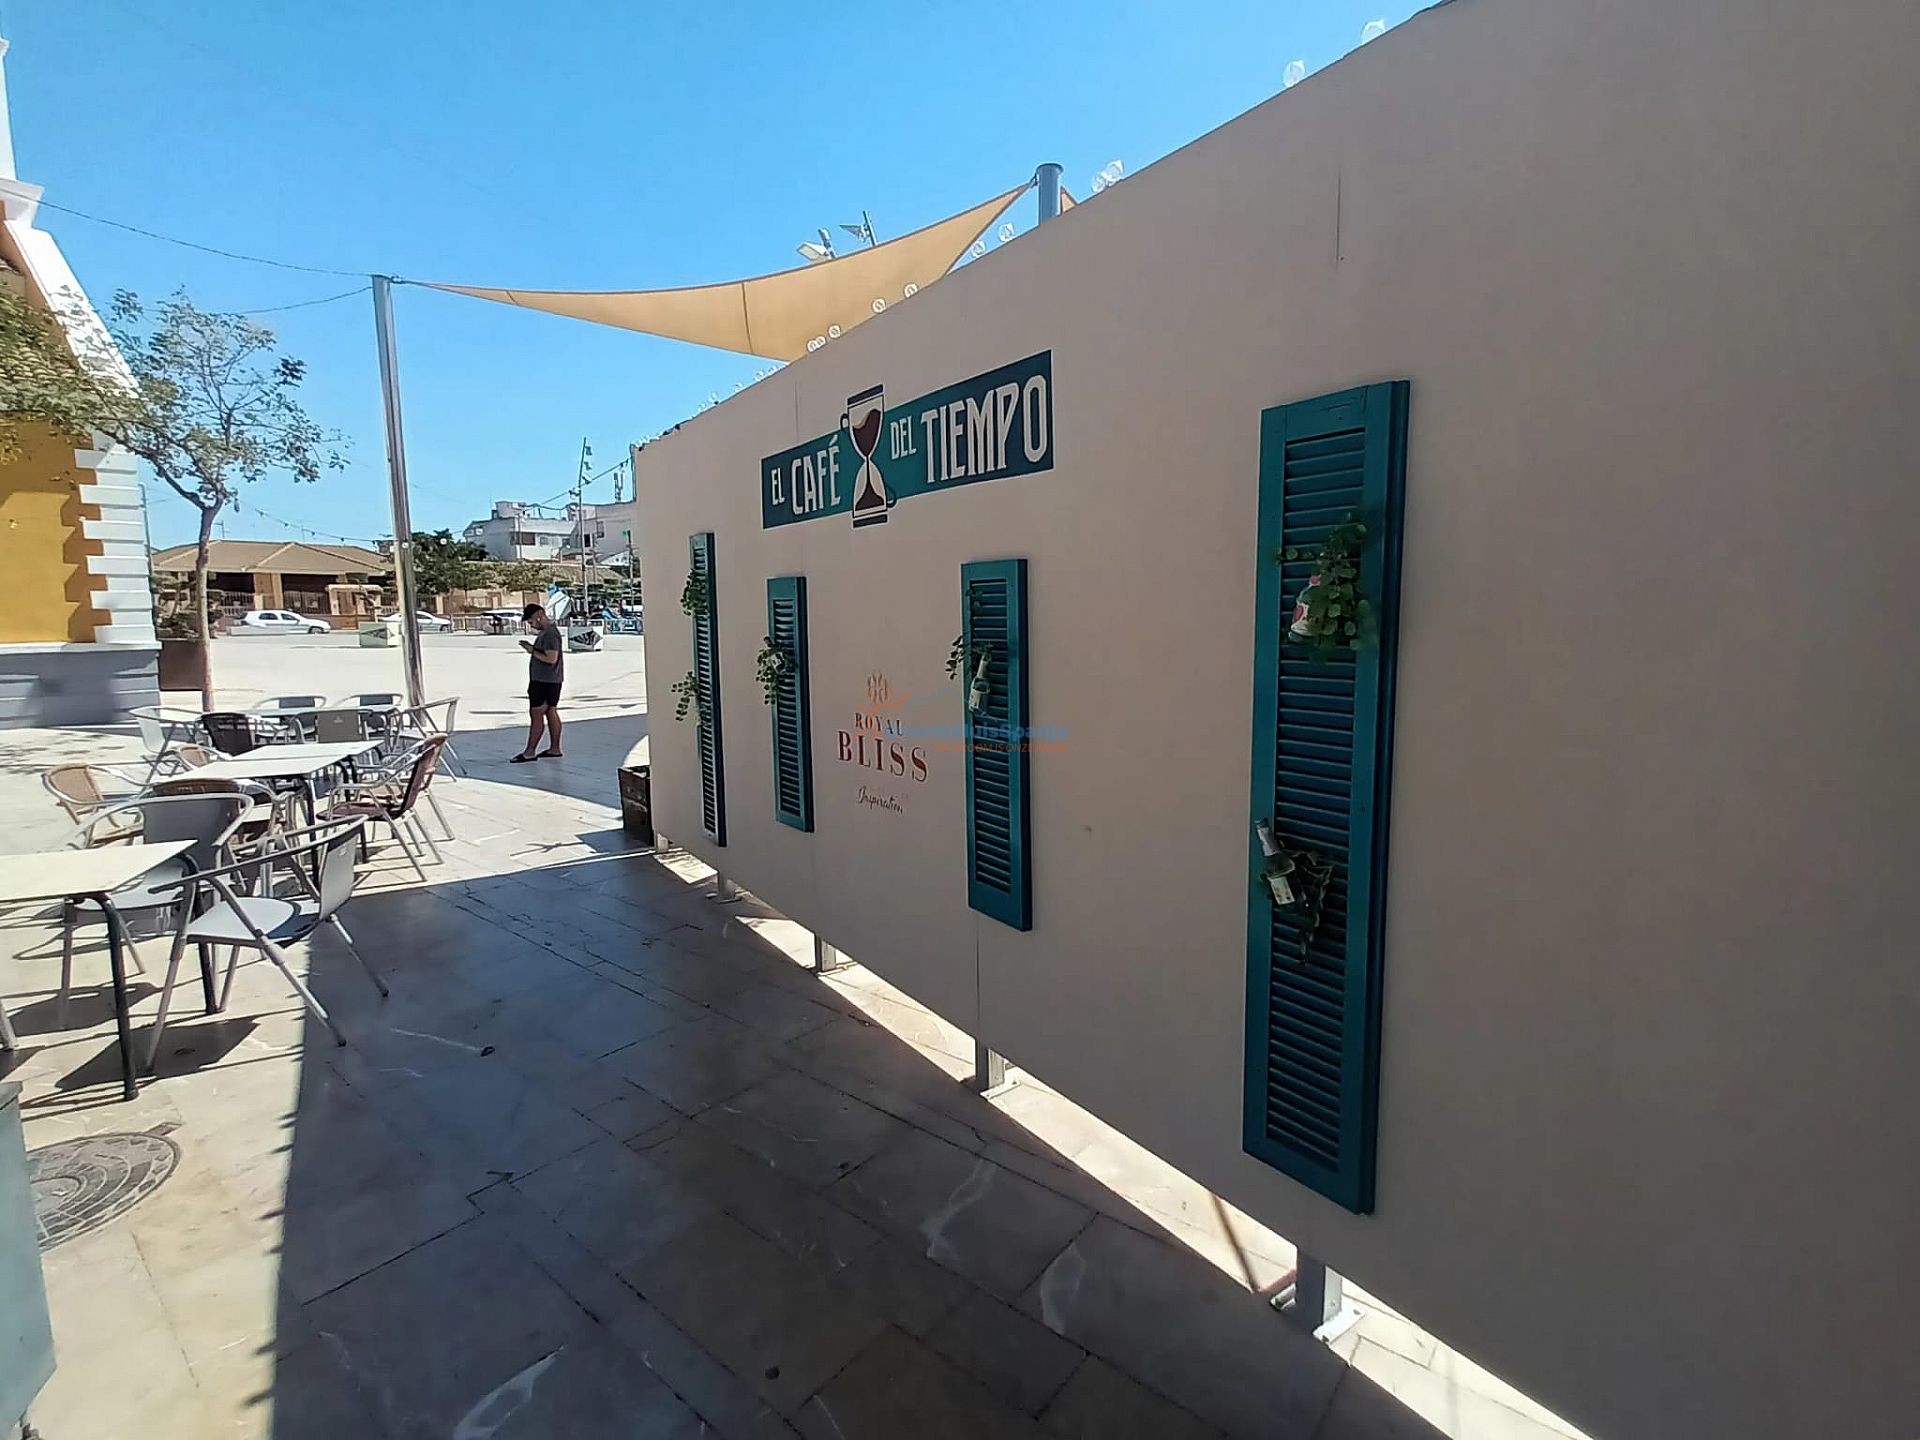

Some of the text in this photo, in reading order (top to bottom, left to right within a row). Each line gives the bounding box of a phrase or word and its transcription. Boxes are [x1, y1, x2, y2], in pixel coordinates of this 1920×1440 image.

[771, 374, 1048, 515] EL CAFÉ DEL TIEMPO
[855, 712, 904, 737] ROYAL
[838, 730, 929, 783] BLISS
